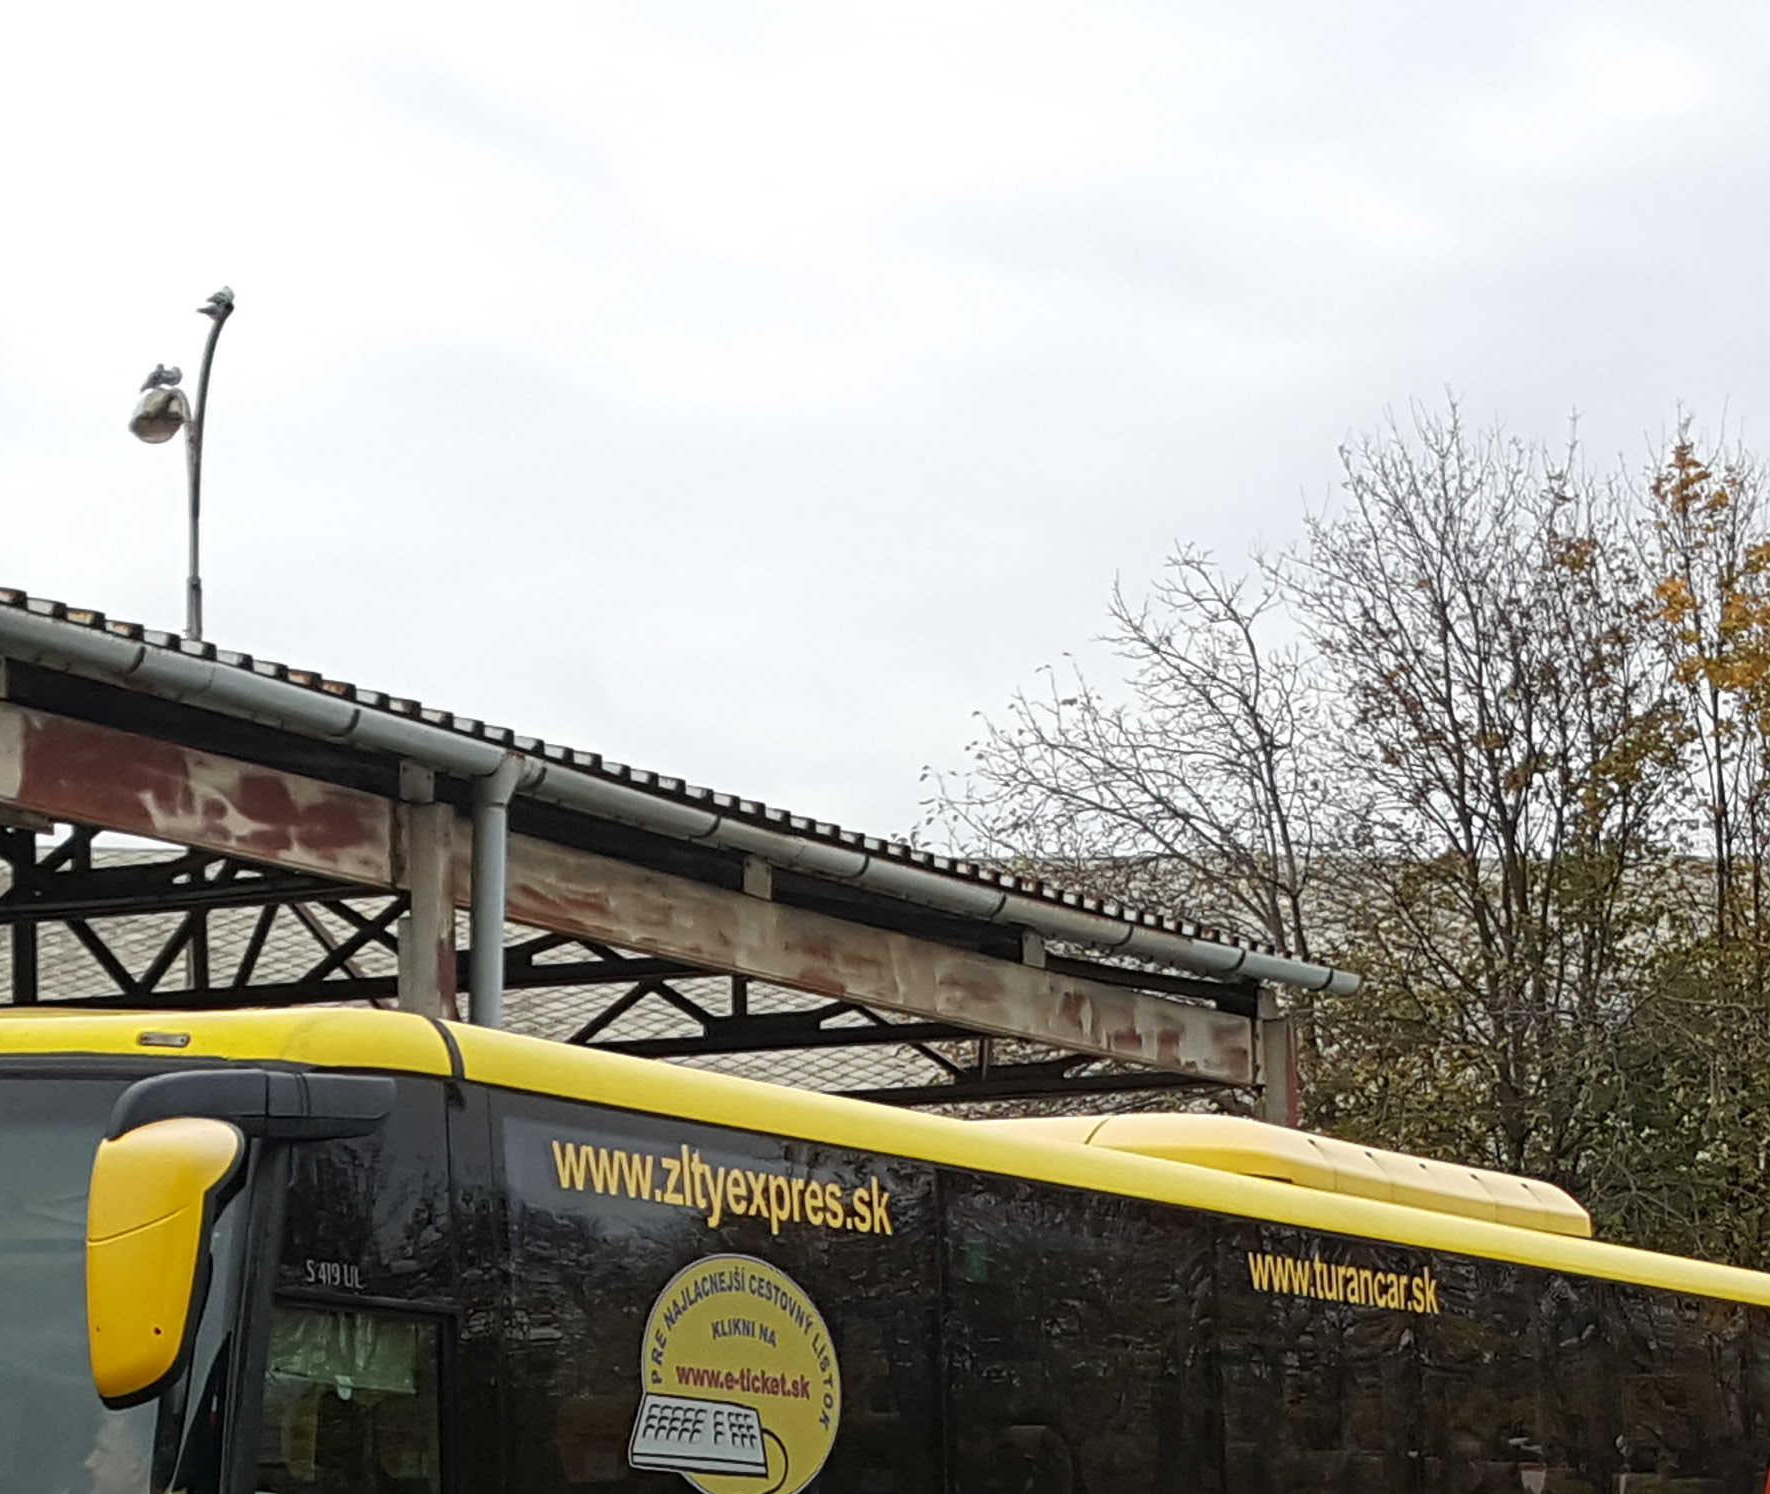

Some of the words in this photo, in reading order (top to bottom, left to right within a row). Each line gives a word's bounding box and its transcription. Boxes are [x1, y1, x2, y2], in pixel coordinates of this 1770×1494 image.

[552, 1140, 894, 1236] www.zltyexpres.sk
[1247, 1251, 1440, 1315] www.turancar.sk
[651, 1329, 667, 1385] PRE
[711, 1318, 755, 1340] KLIKNI
[759, 1323, 777, 1348] NA
[675, 1365, 811, 1400] www.e-ticket.sk
